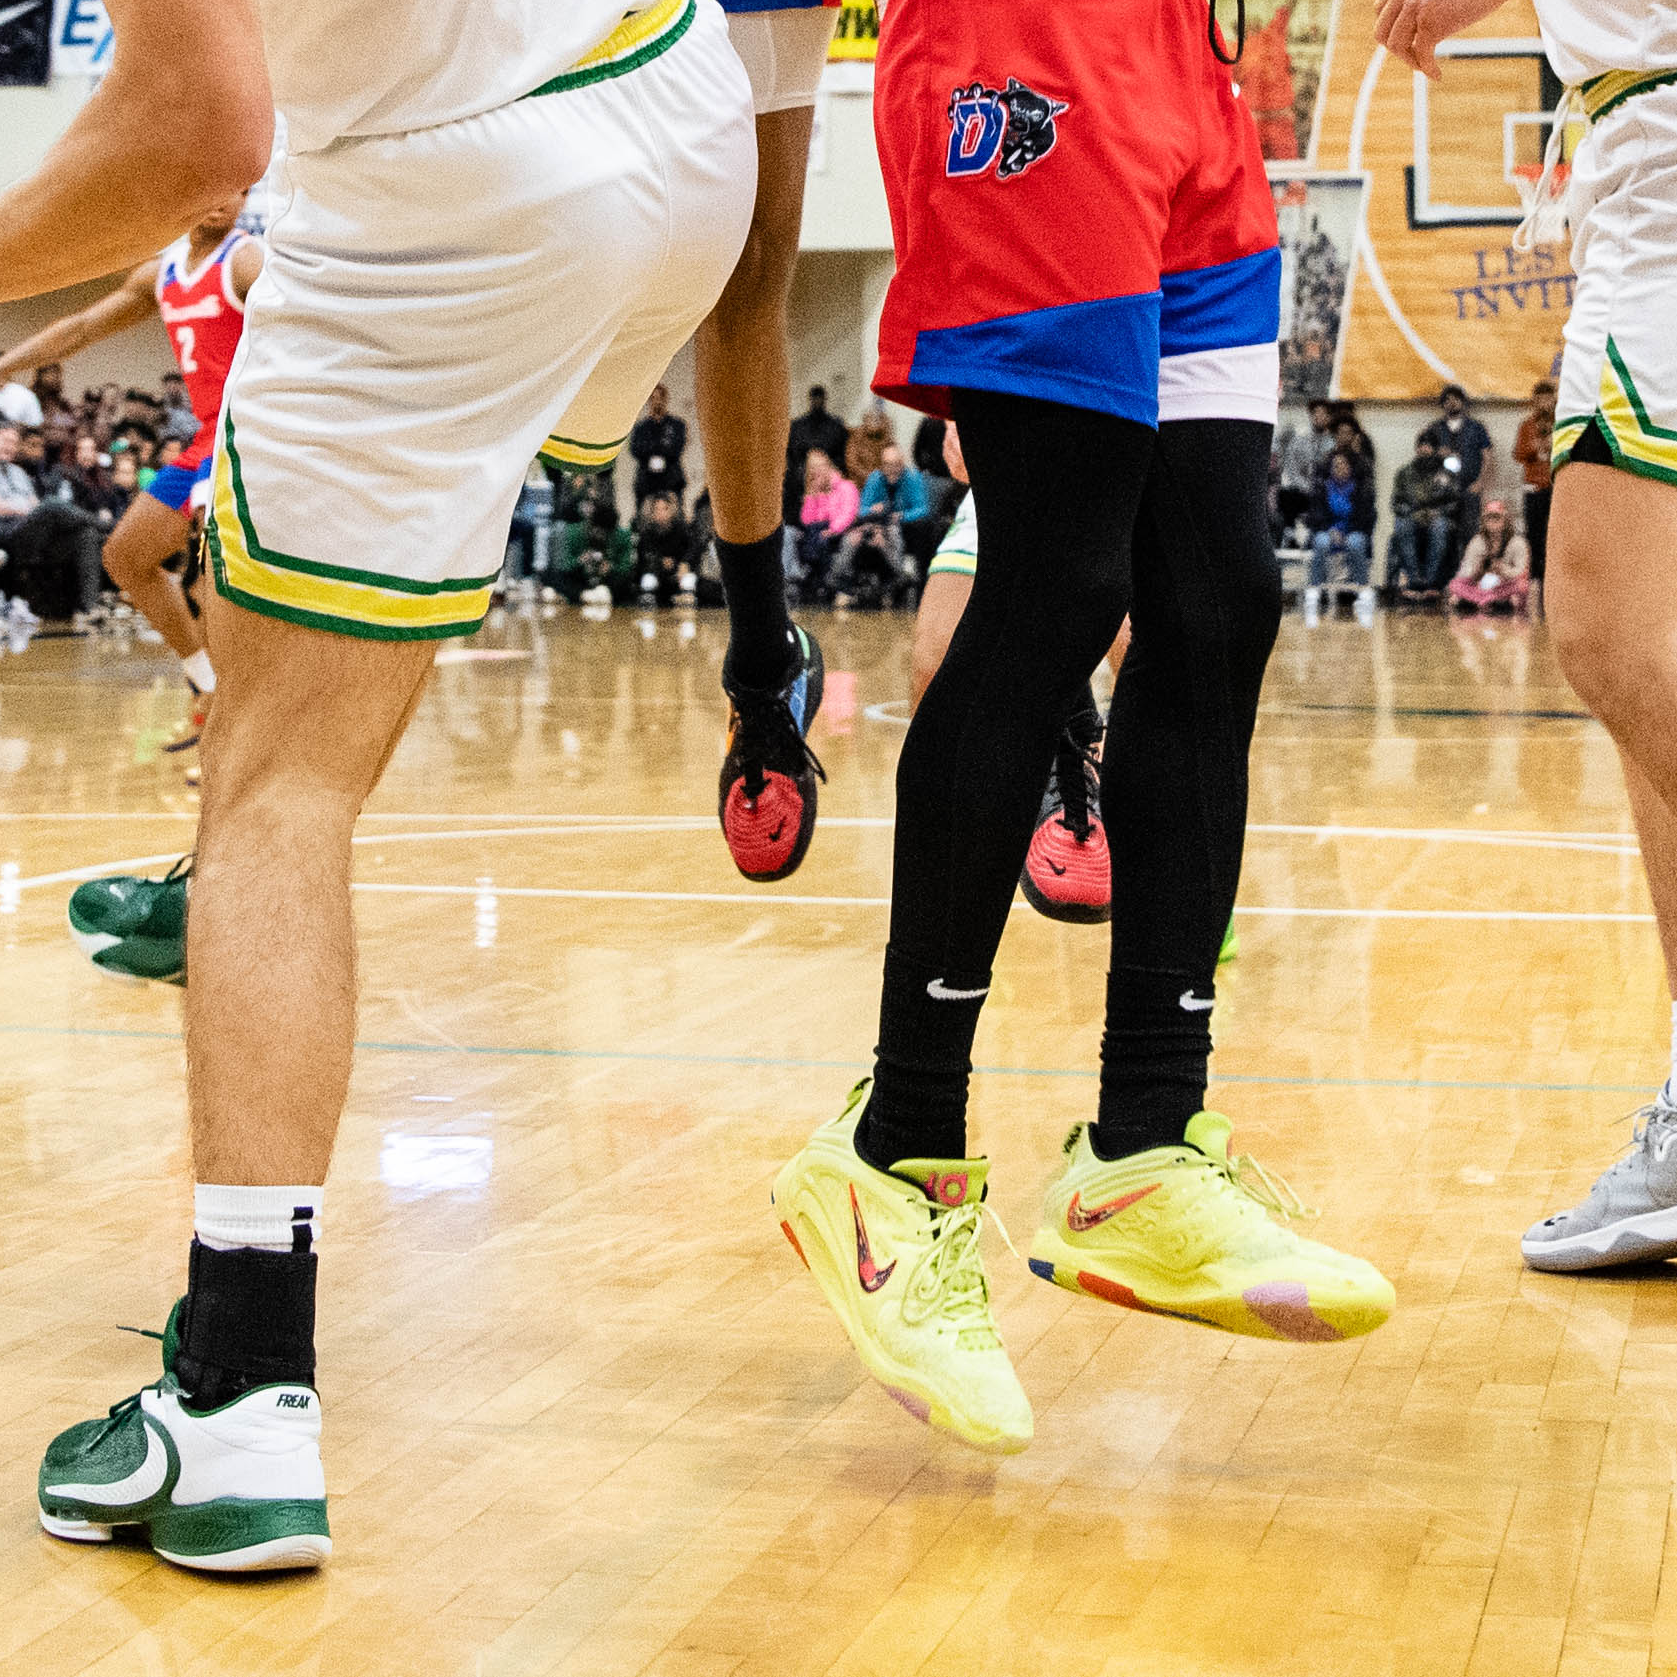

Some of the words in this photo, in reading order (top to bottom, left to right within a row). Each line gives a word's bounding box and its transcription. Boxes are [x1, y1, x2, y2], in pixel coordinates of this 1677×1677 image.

[1475, 244, 1556, 280] LES
[175, 325, 199, 375] 2
[276, 1393, 311, 1410] FREAK
